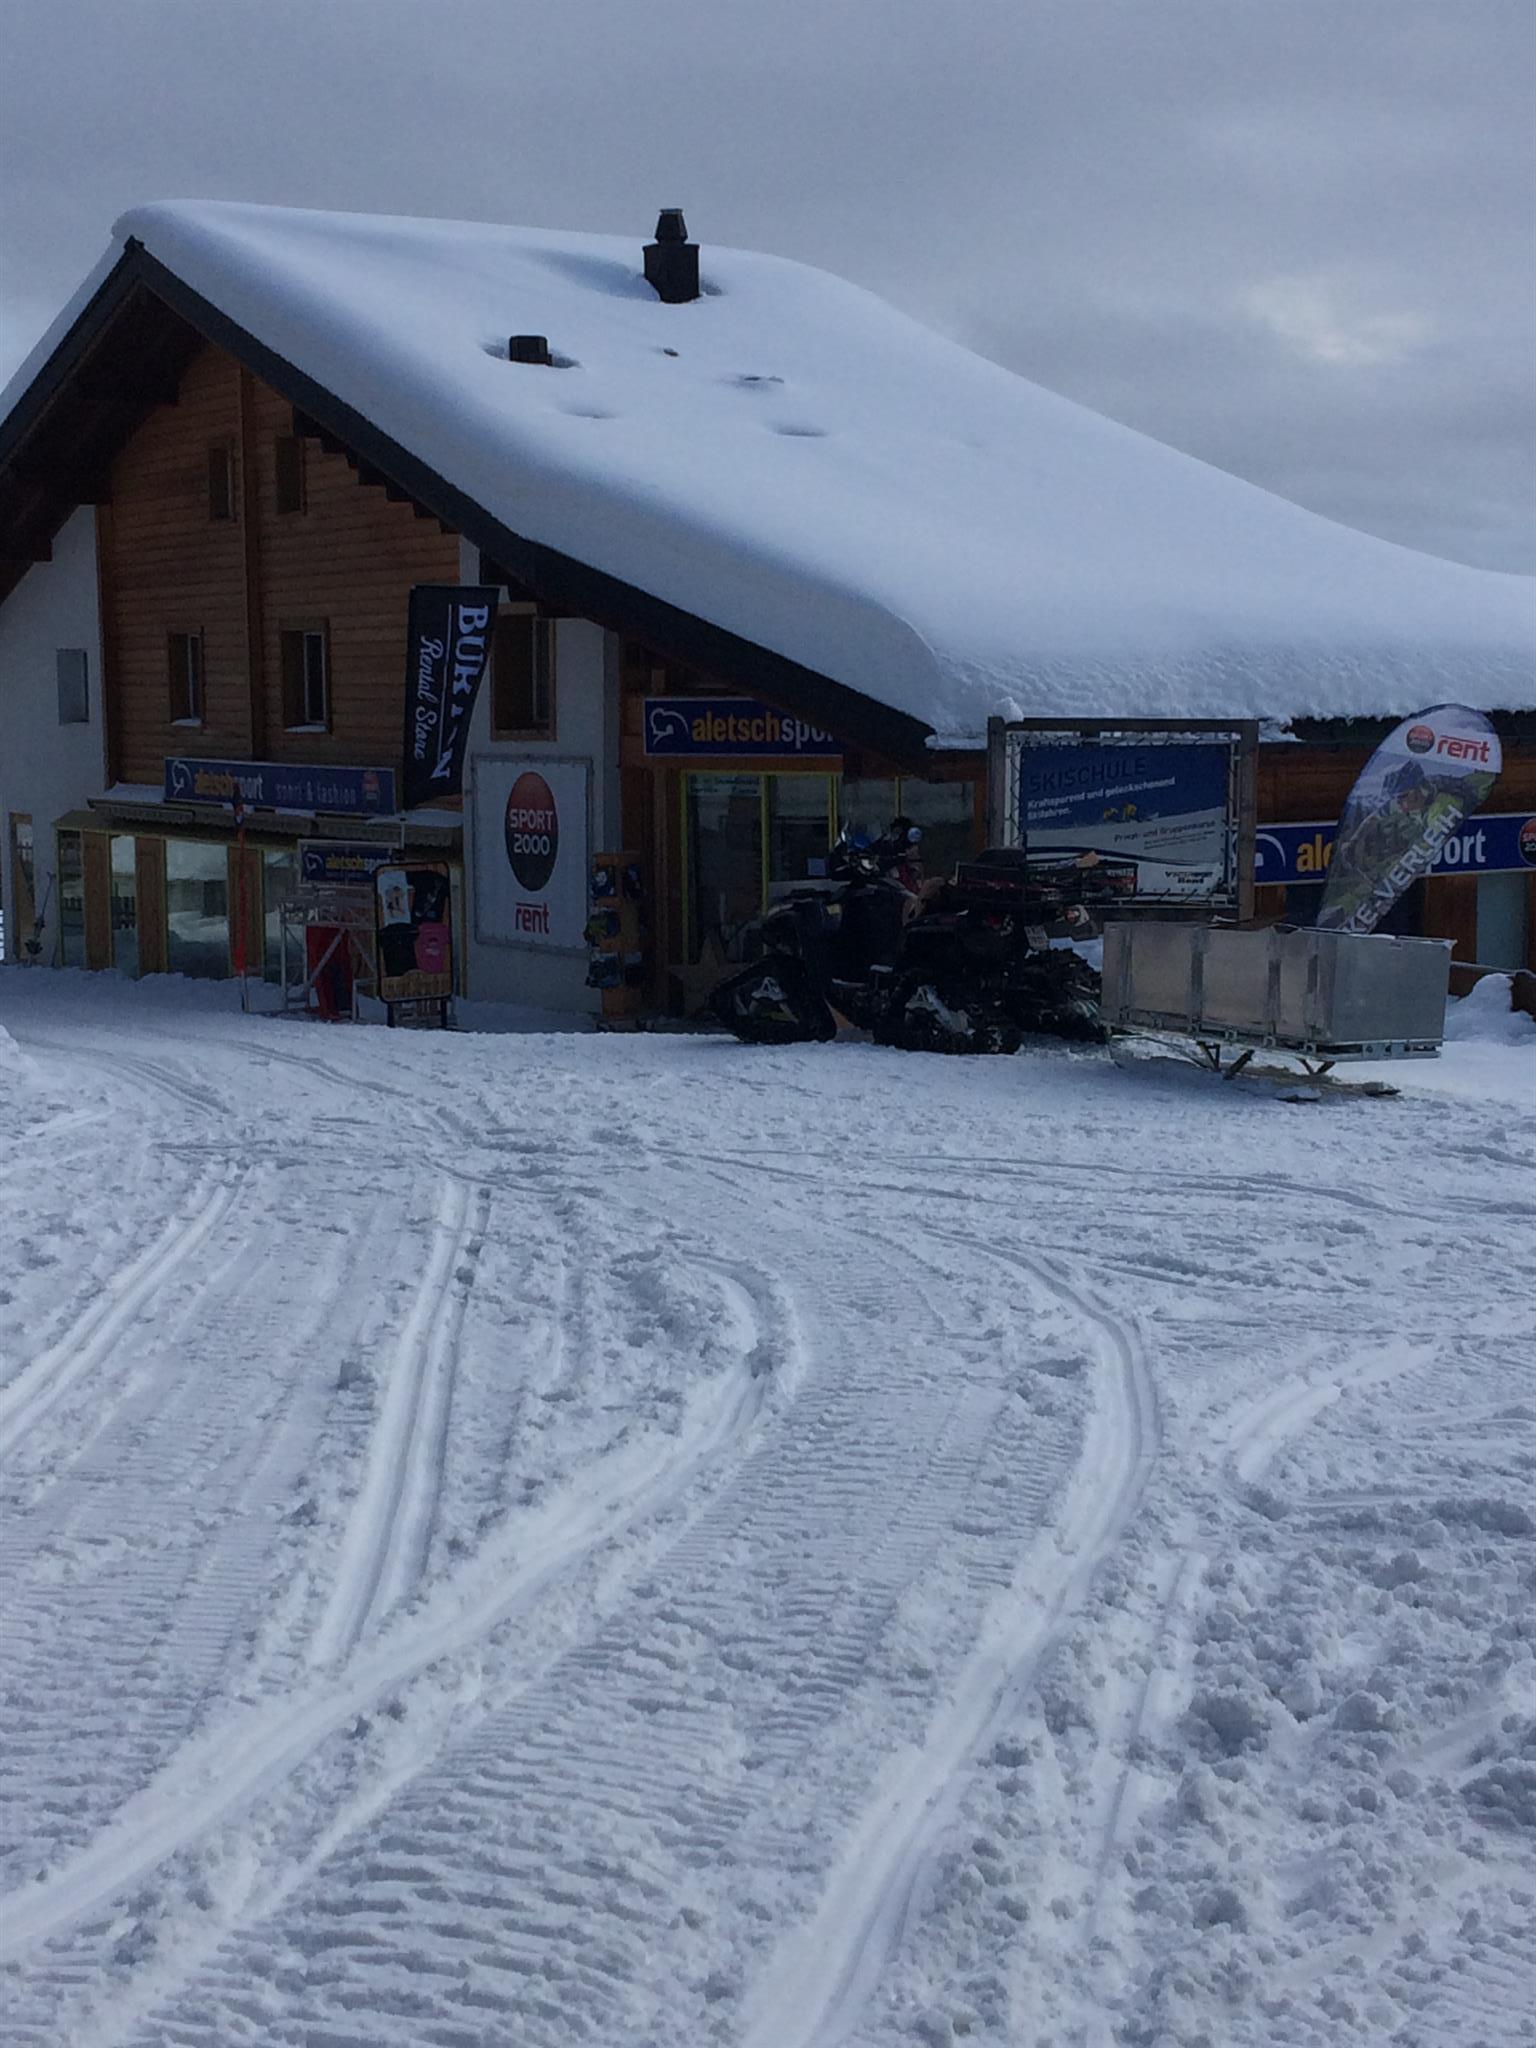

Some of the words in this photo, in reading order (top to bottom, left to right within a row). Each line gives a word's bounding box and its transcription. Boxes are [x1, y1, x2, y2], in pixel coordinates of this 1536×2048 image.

[417, 635, 444, 705] Rental
[414, 706, 438, 760] Store
[692, 710, 833, 749] aletschspo
[1436, 734, 1490, 763] rent
[1030, 757, 1147, 793] SKISCHULE
[274, 782, 302, 801] sport
[306, 780, 314, 801] &
[316, 781, 357, 805] fashion
[1086, 788, 1104, 800] und
[510, 809, 553, 830] SPORT
[513, 833, 550, 856] 2000
[1343, 805, 1464, 932] KE-VERLEIH
[515, 901, 550, 934] rent
